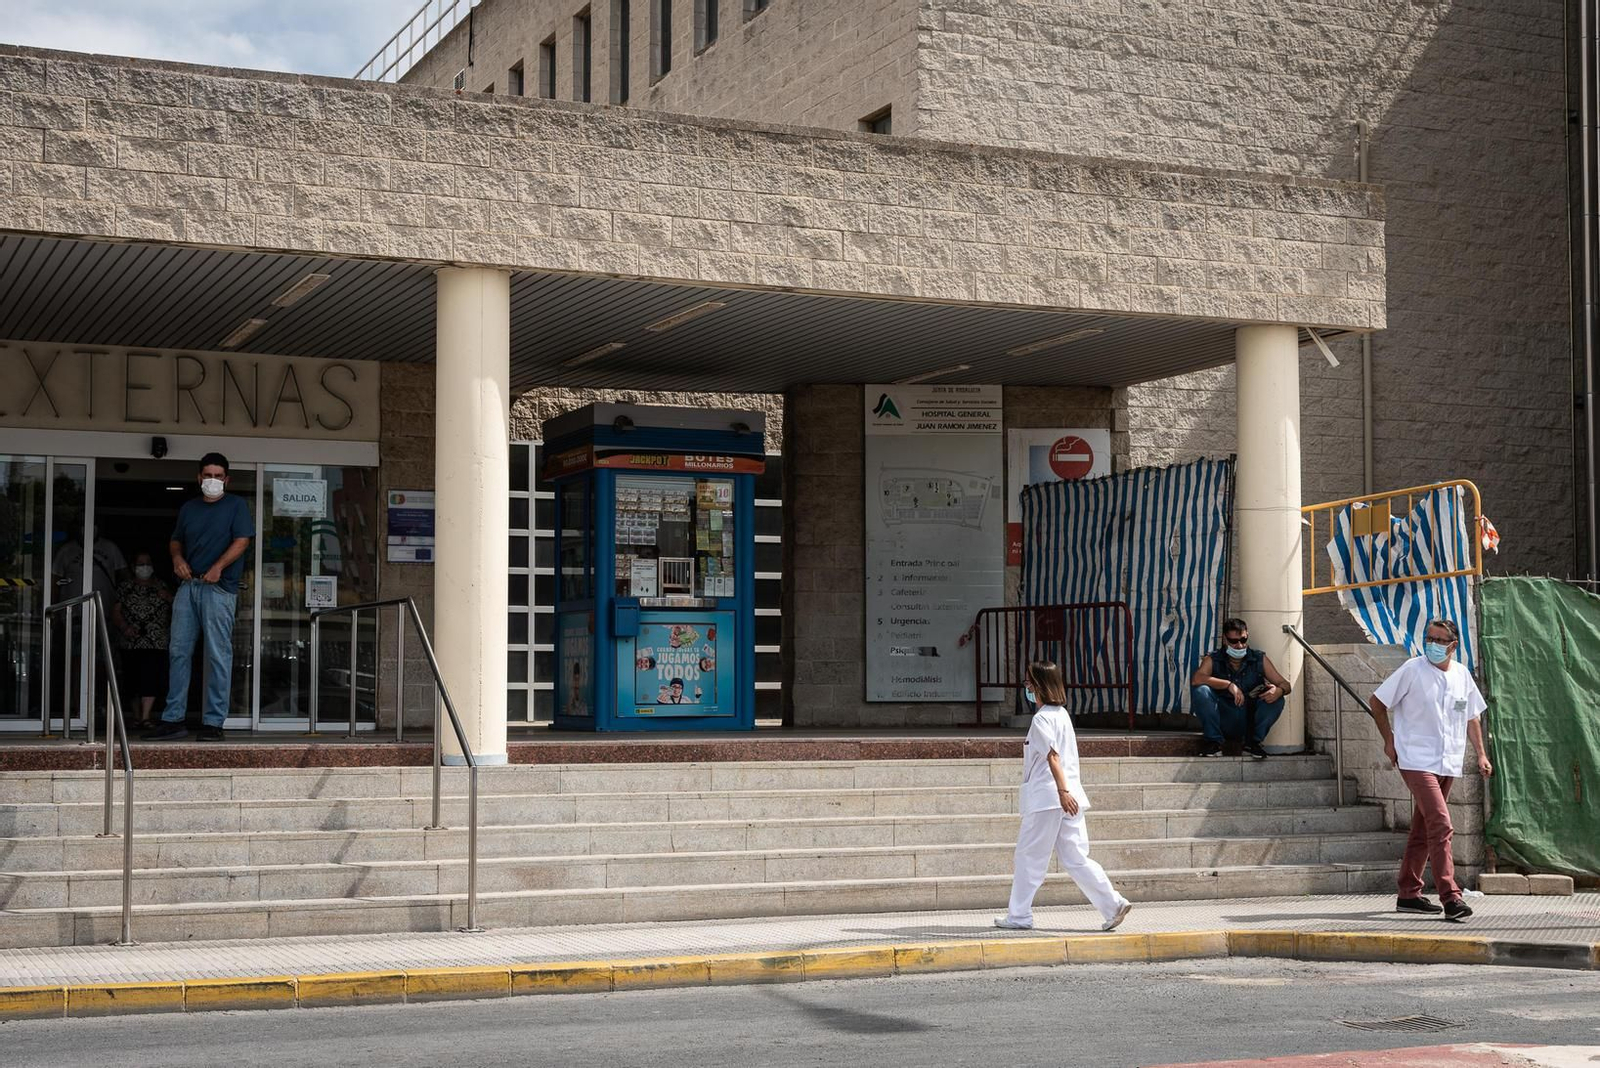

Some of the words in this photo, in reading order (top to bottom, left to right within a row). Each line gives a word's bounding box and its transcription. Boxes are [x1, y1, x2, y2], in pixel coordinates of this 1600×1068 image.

[0, 344, 357, 431] XTERNAS
[629, 454, 669, 466] JACKPOT
[684, 461, 734, 469] MILLONARIOS
[282, 494, 317, 503] SALIDA
[890, 559, 923, 567] Entrada
[656, 653, 700, 664] JUGAMOS
[656, 664, 701, 681] TODOS
